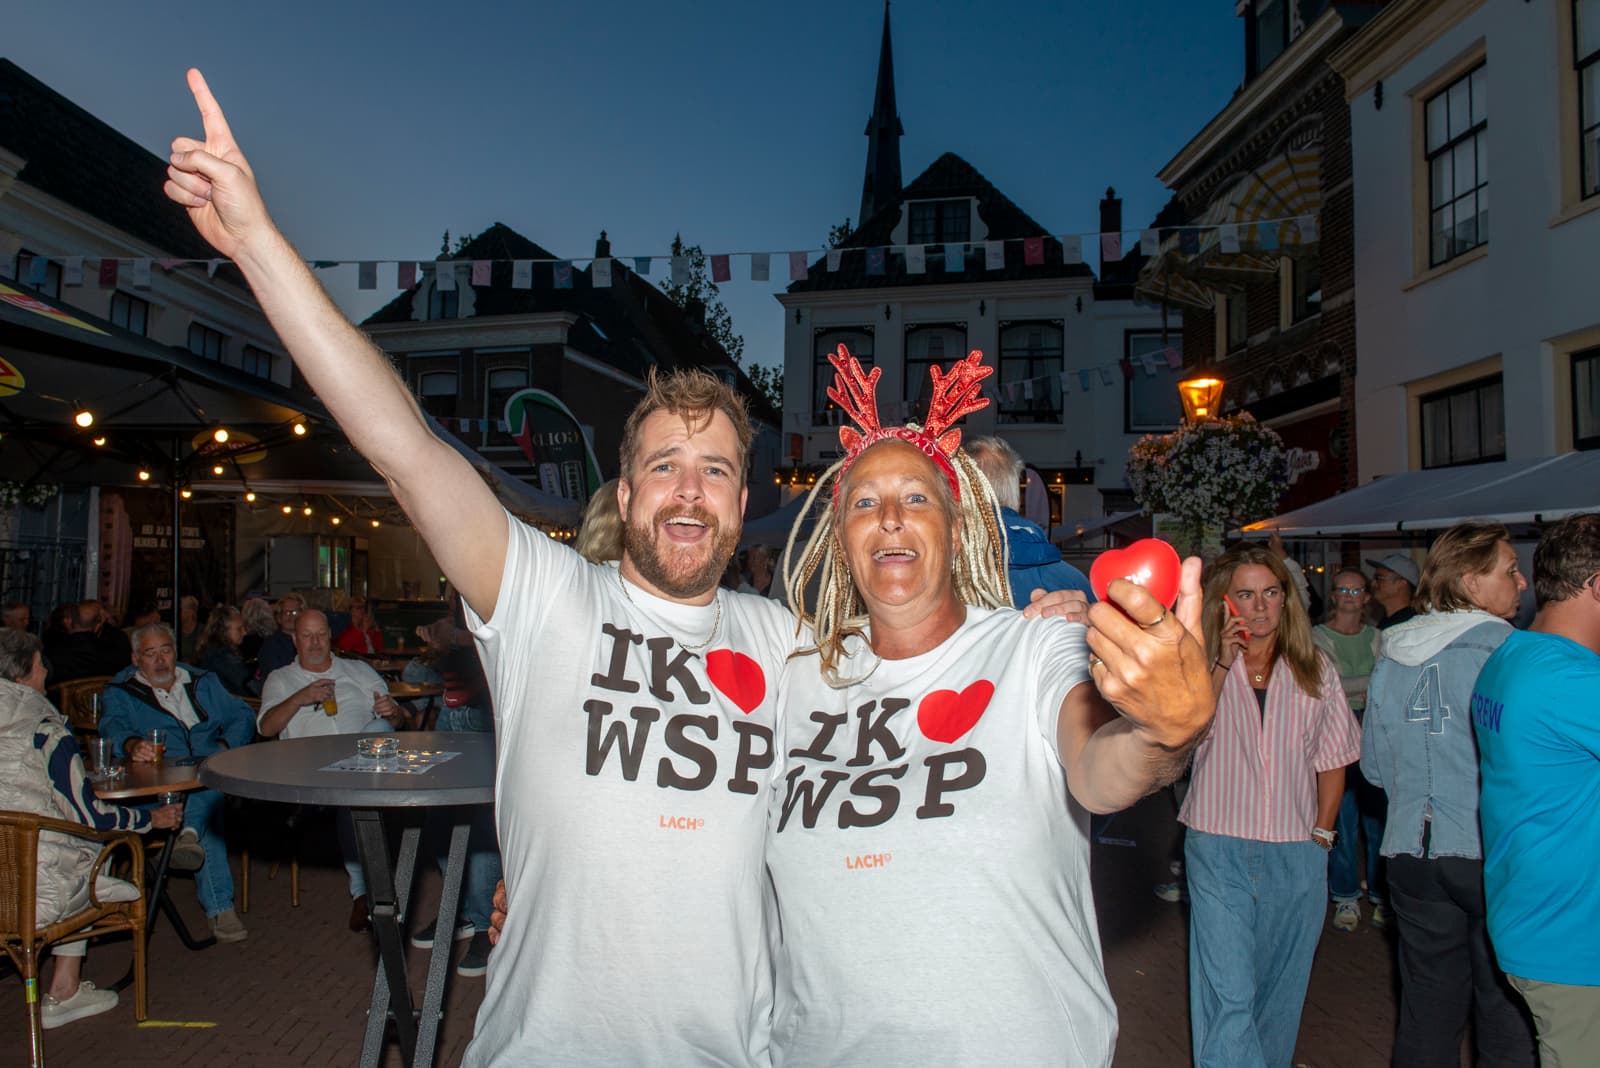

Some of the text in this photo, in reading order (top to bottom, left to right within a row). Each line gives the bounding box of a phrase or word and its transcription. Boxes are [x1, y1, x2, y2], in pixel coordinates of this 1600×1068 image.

[1405, 663, 1451, 735] 4
[583, 699, 774, 795] WSP
[777, 747, 986, 834] WSP
